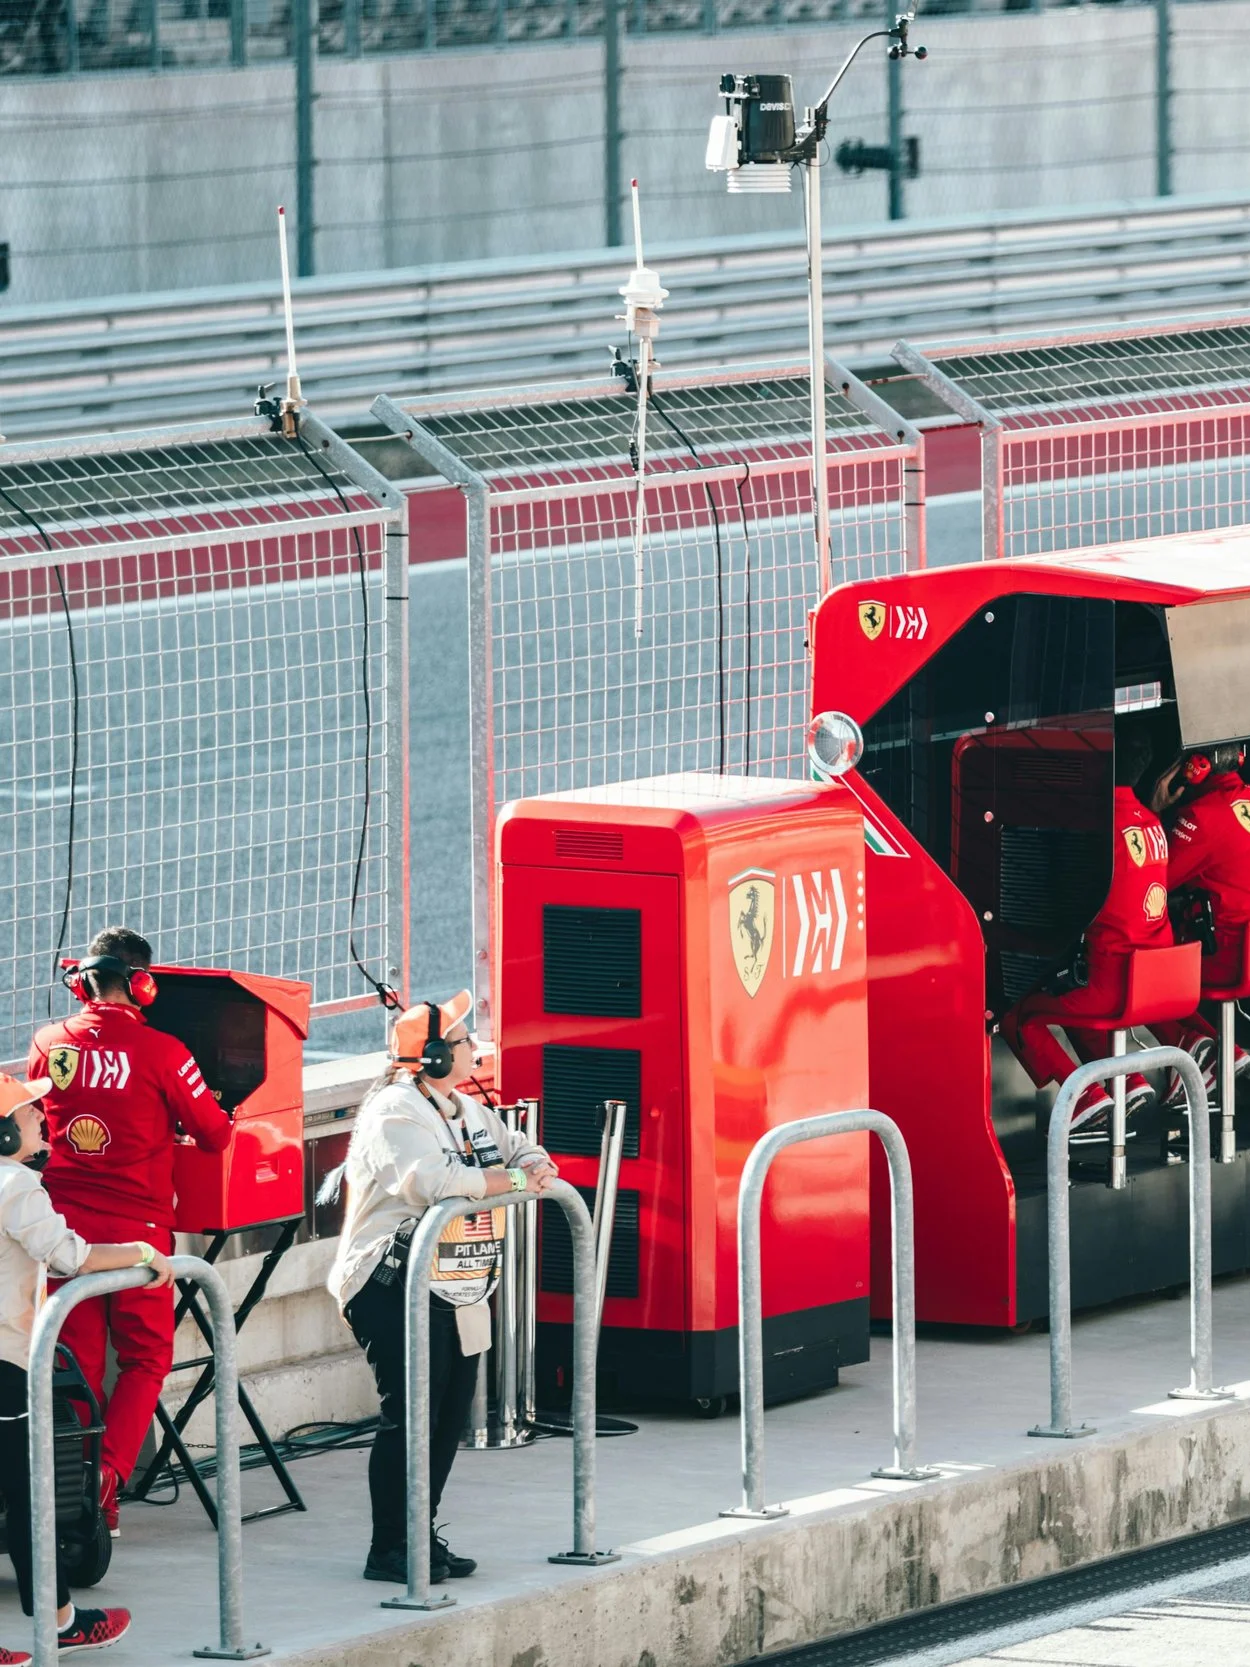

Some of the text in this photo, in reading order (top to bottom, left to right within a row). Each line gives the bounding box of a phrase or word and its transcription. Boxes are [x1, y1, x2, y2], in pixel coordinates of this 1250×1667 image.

[454, 1241, 502, 1257] PIT LANE
[456, 1261, 473, 1269] ALL
